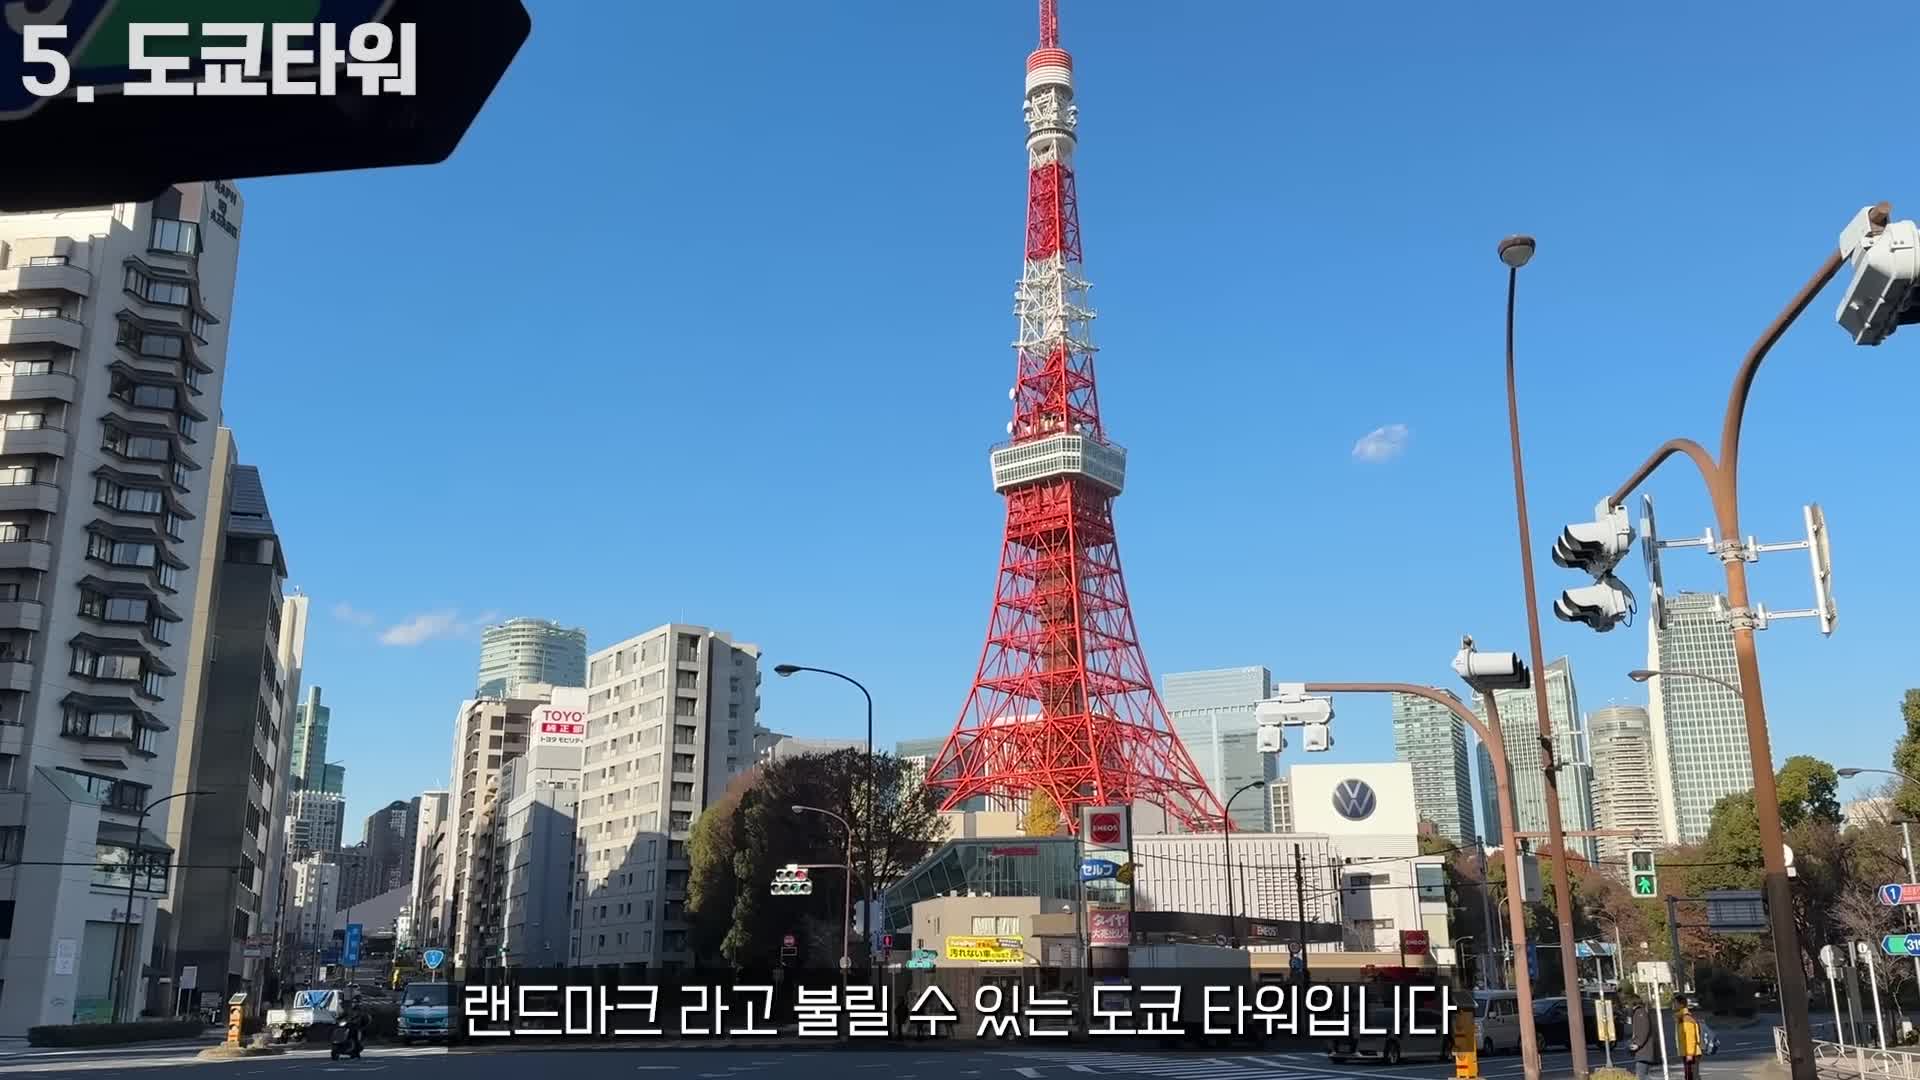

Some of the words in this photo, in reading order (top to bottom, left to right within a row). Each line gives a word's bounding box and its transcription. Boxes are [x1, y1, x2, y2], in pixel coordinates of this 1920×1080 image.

[542, 710, 585, 722] TOYO
[1092, 824, 1118, 832] ENEOS
[1080, 863, 1114, 877] セルフ
[1889, 887, 1897, 900] 1
